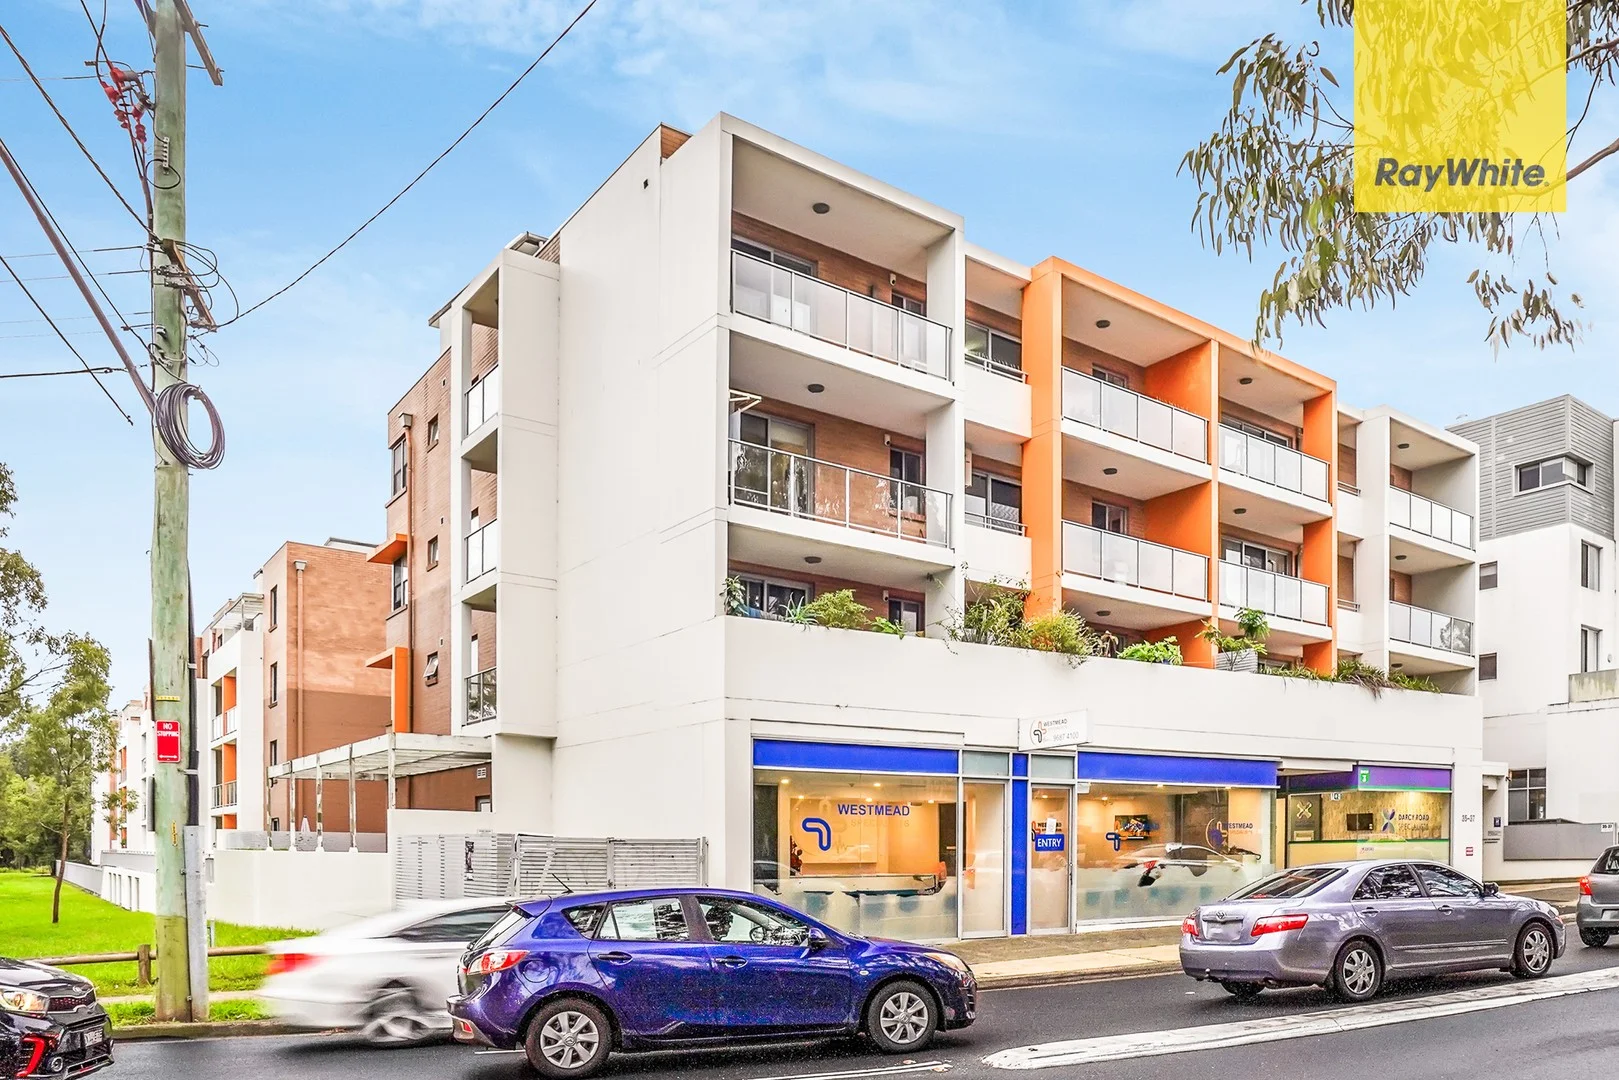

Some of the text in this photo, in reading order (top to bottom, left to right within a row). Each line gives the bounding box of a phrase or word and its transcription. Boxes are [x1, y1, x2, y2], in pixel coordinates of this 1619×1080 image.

[1043, 718, 1068, 727] WESTMEAD
[838, 804, 910, 816] WESTMEAD
[1037, 838, 1062, 848] ENTRY
